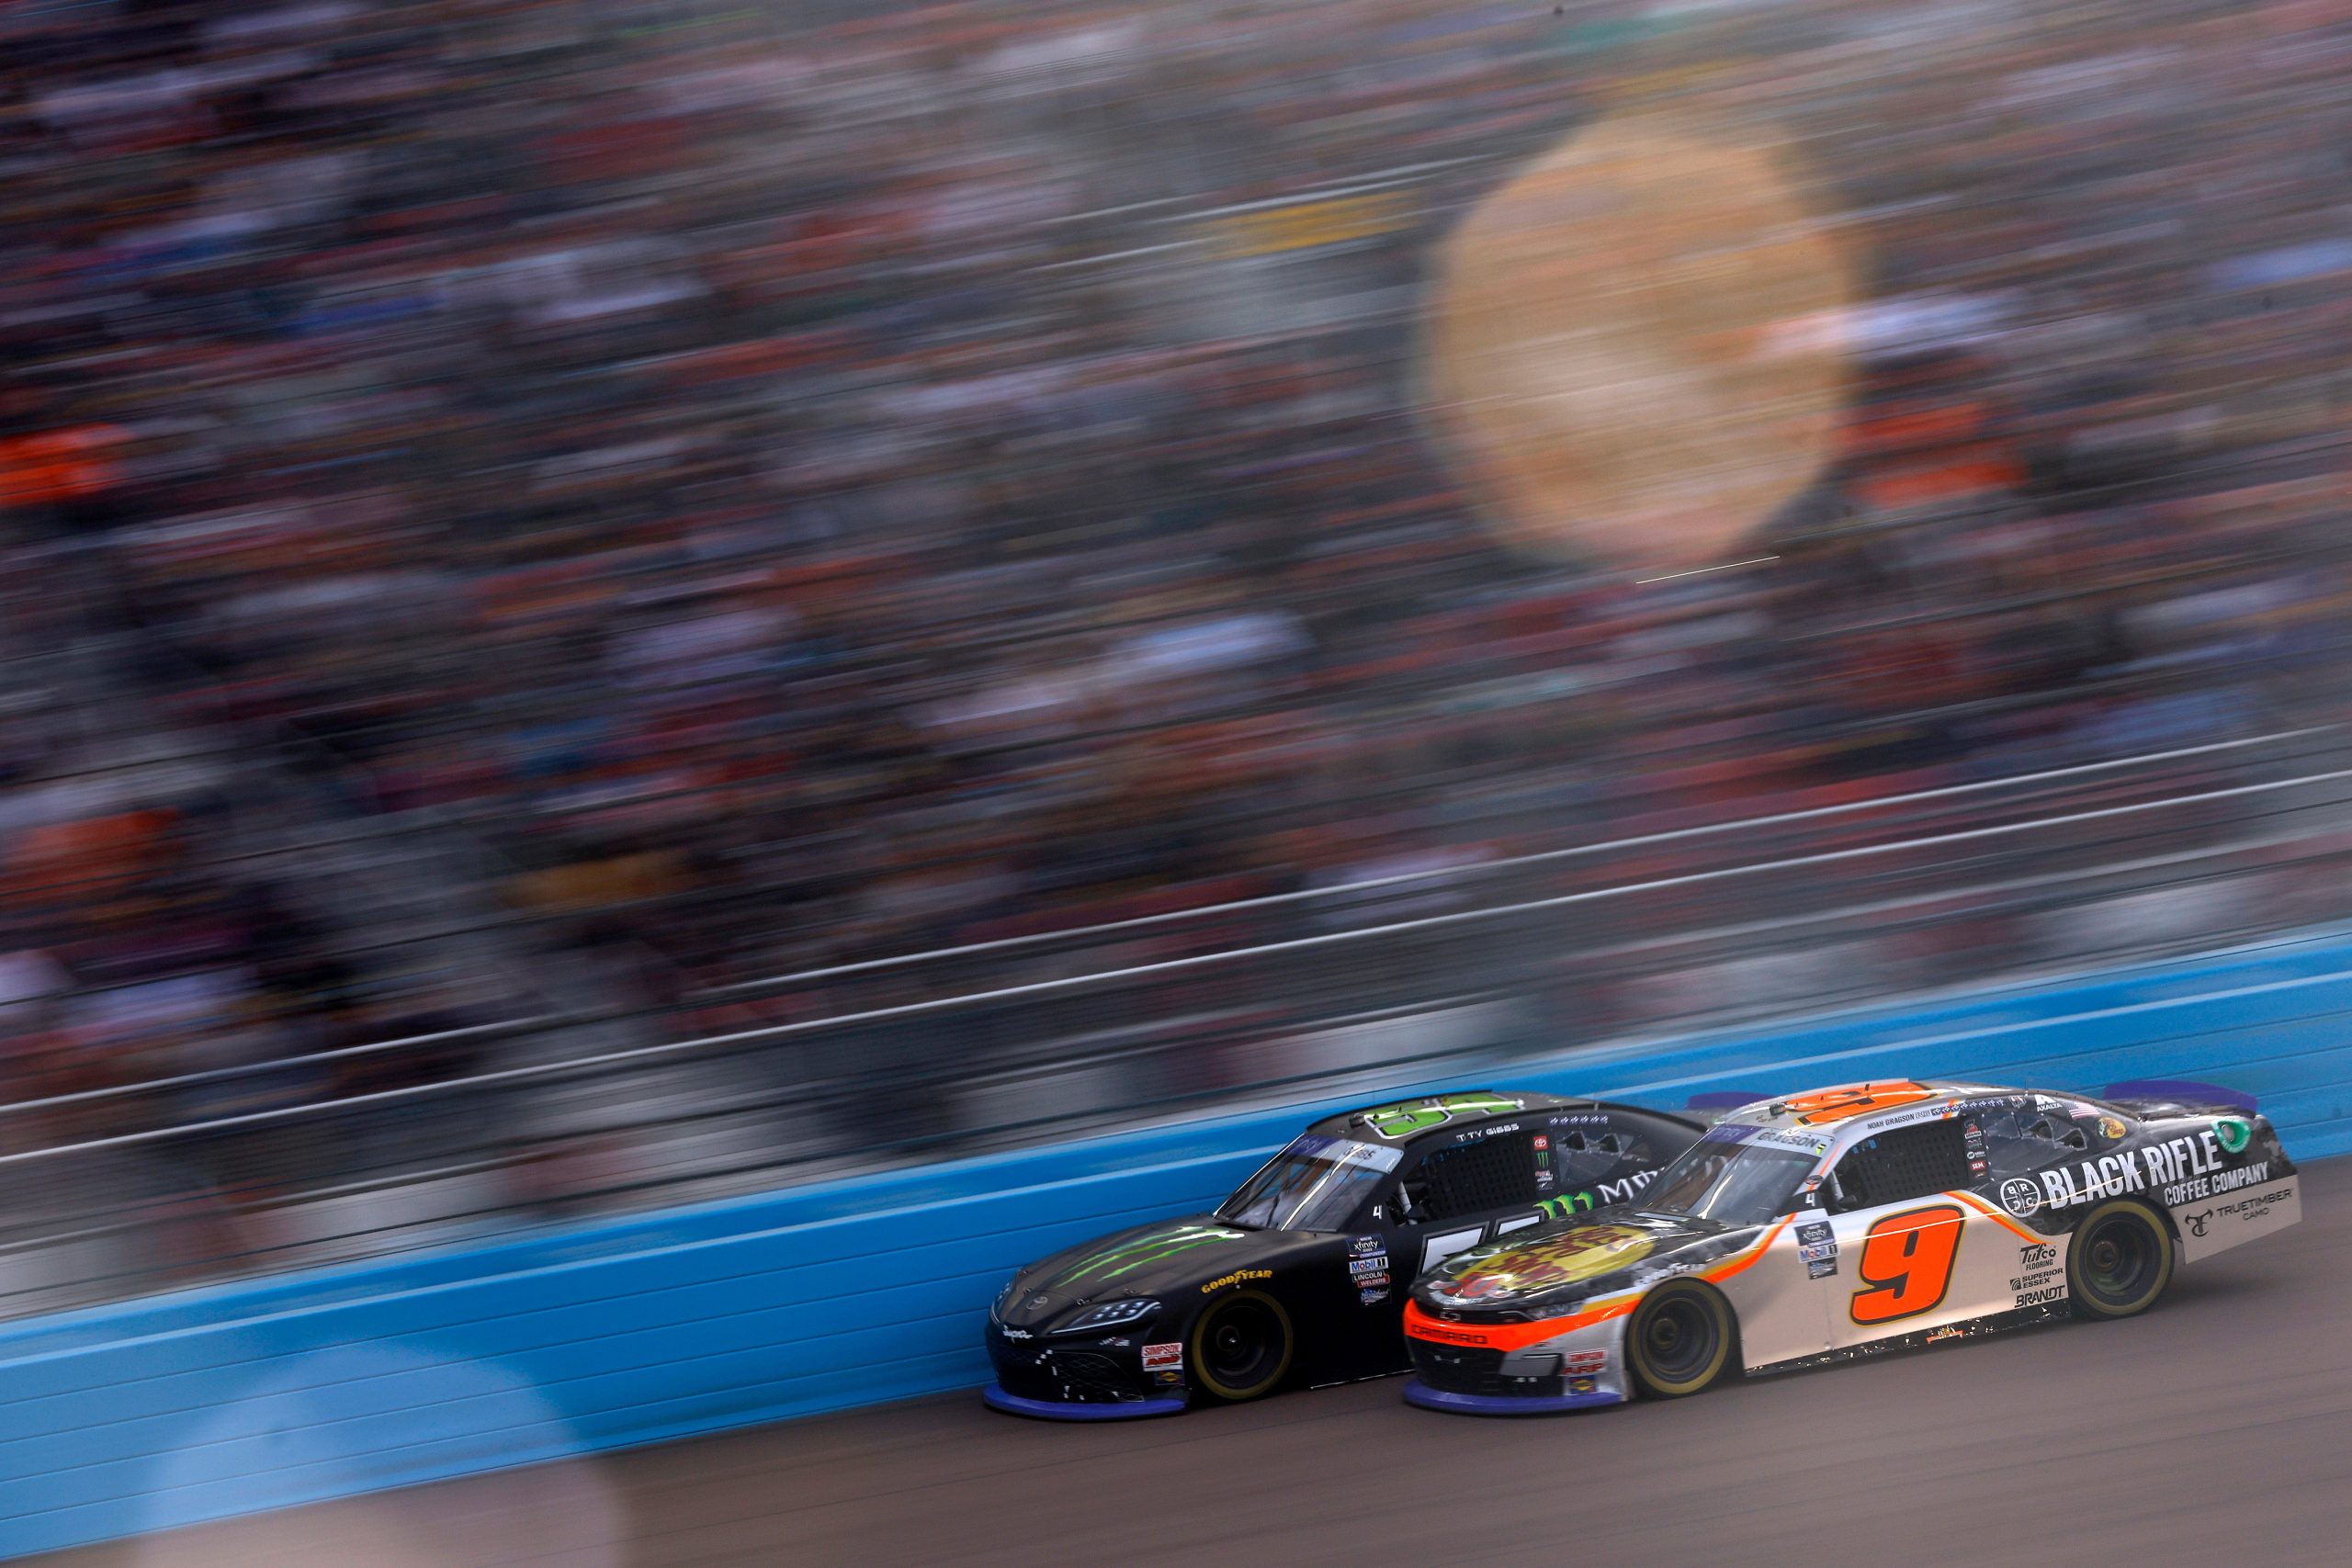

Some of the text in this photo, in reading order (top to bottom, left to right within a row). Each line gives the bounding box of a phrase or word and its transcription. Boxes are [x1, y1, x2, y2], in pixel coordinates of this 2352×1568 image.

[2037, 1102, 2063, 1112] AXALTA
[1867, 1121, 1884, 1130] NOAH
[1885, 1113, 1915, 1126] GRAGSON
[1467, 1130, 1482, 1139] TY
[2040, 1131, 2222, 1210] BLACK RIFLE
[2164, 1161, 2268, 1206] COFFEE COMPANY
[1805, 1192, 1815, 1207] 4
[2217, 1189, 2292, 1217] TRUETIMBER
[1373, 1205, 1383, 1220] 4
[2243, 1208, 2269, 1221] CAMO
[1354, 1240, 1378, 1251] xfinity
[2020, 1243, 2056, 1264] Tufco
[1351, 1258, 1375, 1270] Mobil
[1850, 1202, 1966, 1327] 9
[2026, 1258, 2053, 1271] FLOORING
[1354, 1271, 1383, 1281] LINCOLN
[2022, 1268, 2064, 1281] SUPERIOR
[1361, 1278, 1386, 1286] WELDERS
[2023, 1277, 2051, 1288] ESSEX
[2014, 1285, 2065, 1308] BRANDT
[1143, 1344, 1181, 1357] SIMPSON
